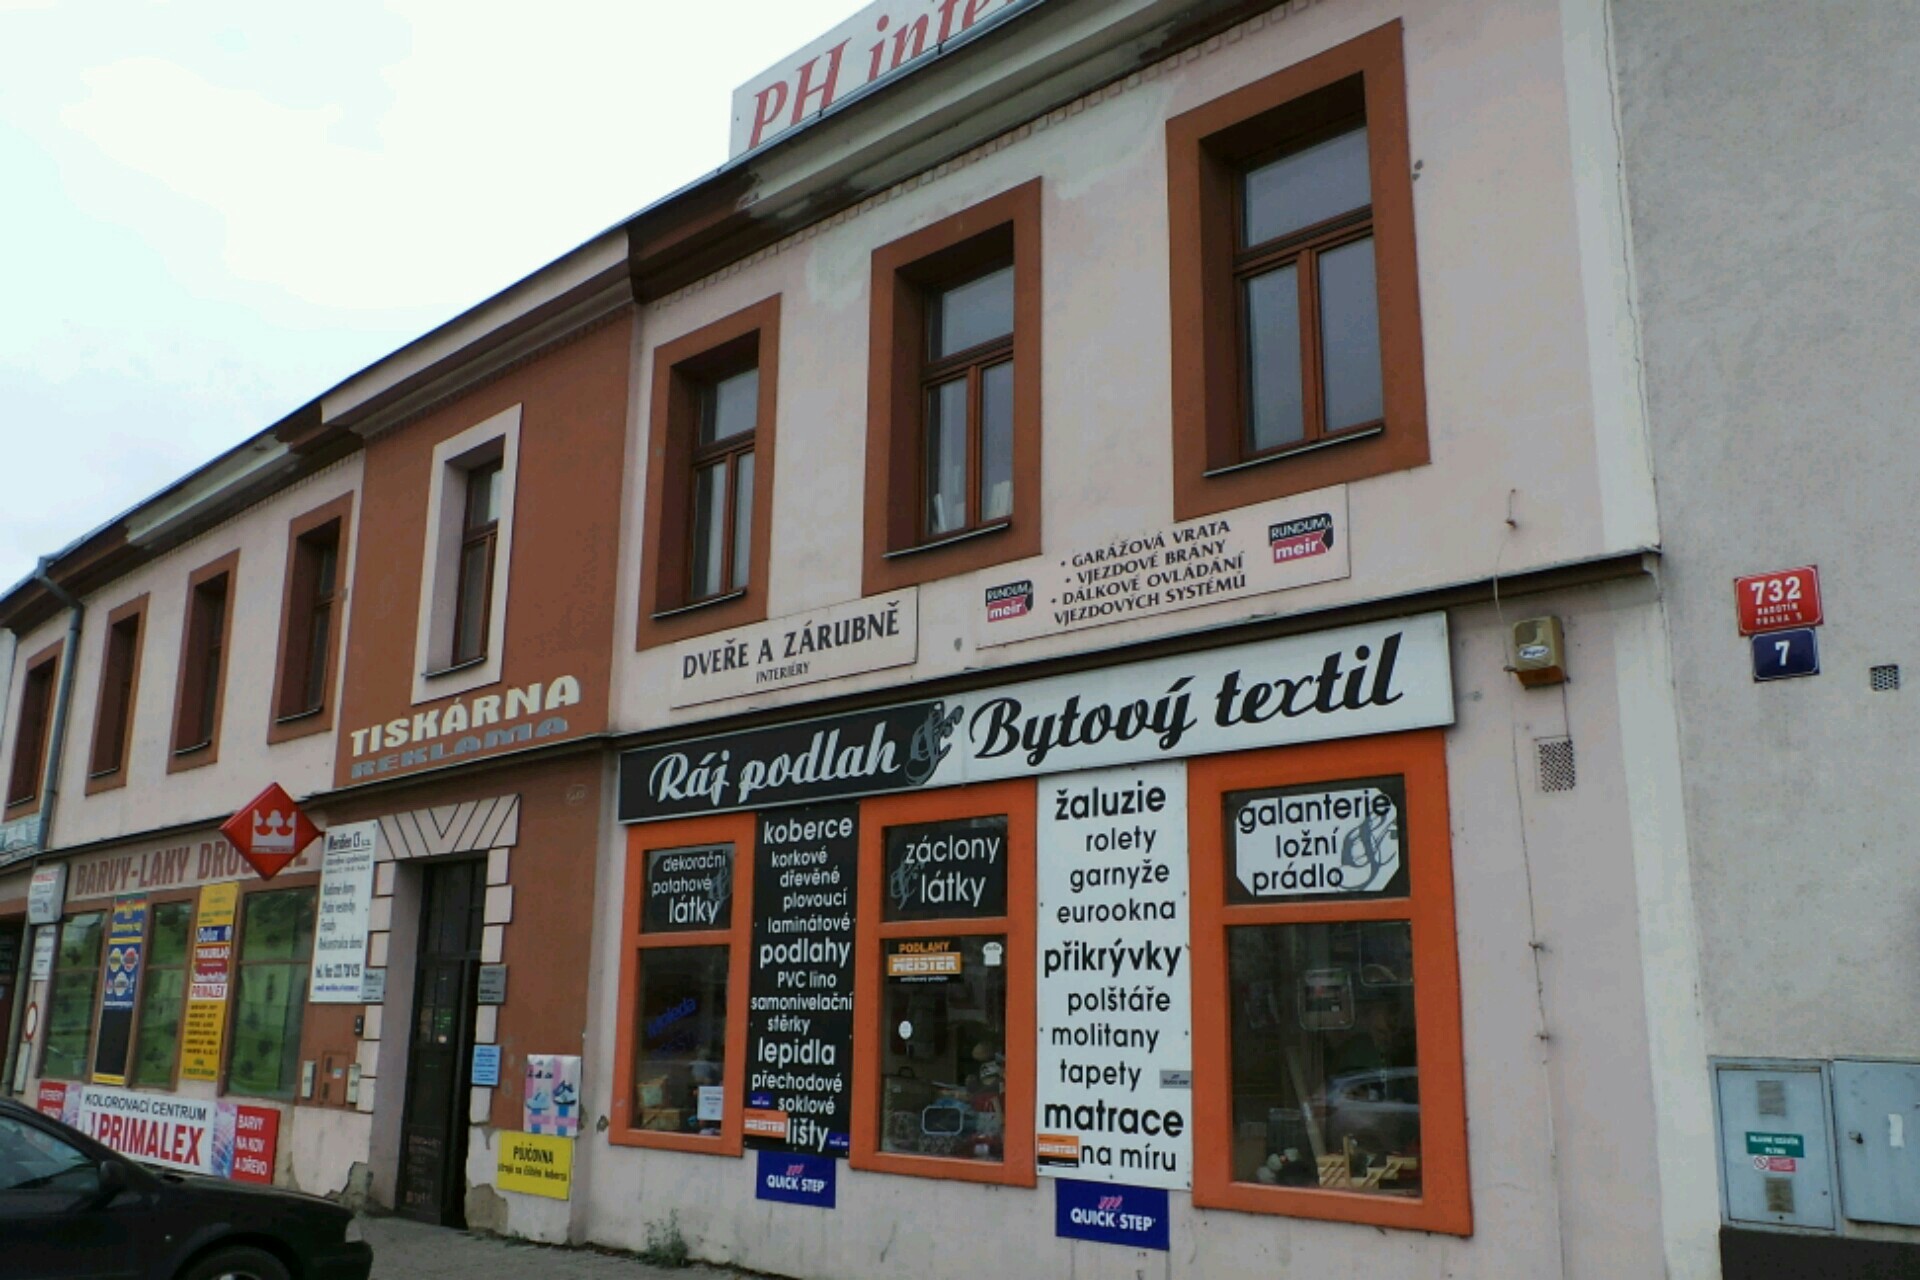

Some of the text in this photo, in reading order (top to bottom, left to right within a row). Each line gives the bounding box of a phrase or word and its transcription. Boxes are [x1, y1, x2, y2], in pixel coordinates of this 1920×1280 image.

[748, 37, 852, 150] PH
[1270, 515, 1331, 539] RUNDUM
[1072, 520, 1231, 568] GARÁŽOVÁ VRATA
[1274, 539, 1319, 561] meir
[1076, 538, 1227, 585] VJEZDOVÉ BRÁNY
[1062, 551, 1247, 606] DÁLKOVÉ OVLÁDÁNÍ
[1750, 576, 1801, 605] 732
[989, 602, 1023, 621] meir
[1054, 573, 1247, 627] VJEZDOVÝCH SYSTÉMŮ
[683, 600, 901, 680] DVEŘE A ZÁRUBNĚ
[1775, 640, 1791, 666] 7
[351, 675, 580, 757] TISKÁRNA
[649, 749, 731, 806] Ráj
[739, 721, 901, 805] podlah
[969, 675, 1197, 767] Bytový
[1215, 632, 1404, 727] textil
[351, 717, 568, 780] REKLAMA
[1055, 780, 1167, 821] žaluzie
[1238, 789, 1392, 835] galanterie
[764, 817, 853, 845] koberce
[1086, 825, 1157, 854] rolety
[1276, 827, 1340, 859] ložní
[663, 850, 726, 873] dekorační
[772, 846, 828, 868] korkové
[905, 834, 1001, 865] záclony
[76, 843, 190, 896] BARVY-LAKY
[780, 865, 840, 888] dřevěné
[1070, 859, 1170, 893] garnyže
[1253, 862, 1343, 897] prádlo
[652, 873, 712, 898] potahové
[783, 887, 848, 913] plovoucí
[921, 870, 986, 908] látky
[669, 894, 720, 925] látky
[768, 912, 851, 934] laminátové
[1056, 898, 1176, 925] eurookna
[760, 937, 851, 970] podlahy
[1044, 938, 1182, 978] přikrývky
[777, 971, 837, 988] PVC lino
[750, 992, 853, 1011] samonivelační
[1068, 986, 1171, 1015] polštáře
[767, 1015, 811, 1036] stěrky
[1052, 1023, 1160, 1053] molitany
[758, 1037, 836, 1069] lepidla
[752, 1070, 843, 1094] přechodové
[1060, 1059, 1141, 1092] tapety
[85, 1093, 149, 1114] KOLOROVACÍ
[151, 1101, 207, 1122] CENTRUM
[778, 1094, 835, 1116] soklové
[1044, 1099, 1184, 1138] matrace
[238, 1114, 265, 1132] BARVY
[785, 1117, 830, 1152] lišty
[98, 1113, 205, 1166] PRIMALEX
[1081, 1143, 1176, 1172] na míru
[767, 1174, 826, 1194] QUICK STEP
[1070, 1207, 1153, 1232] QUICK STEP
